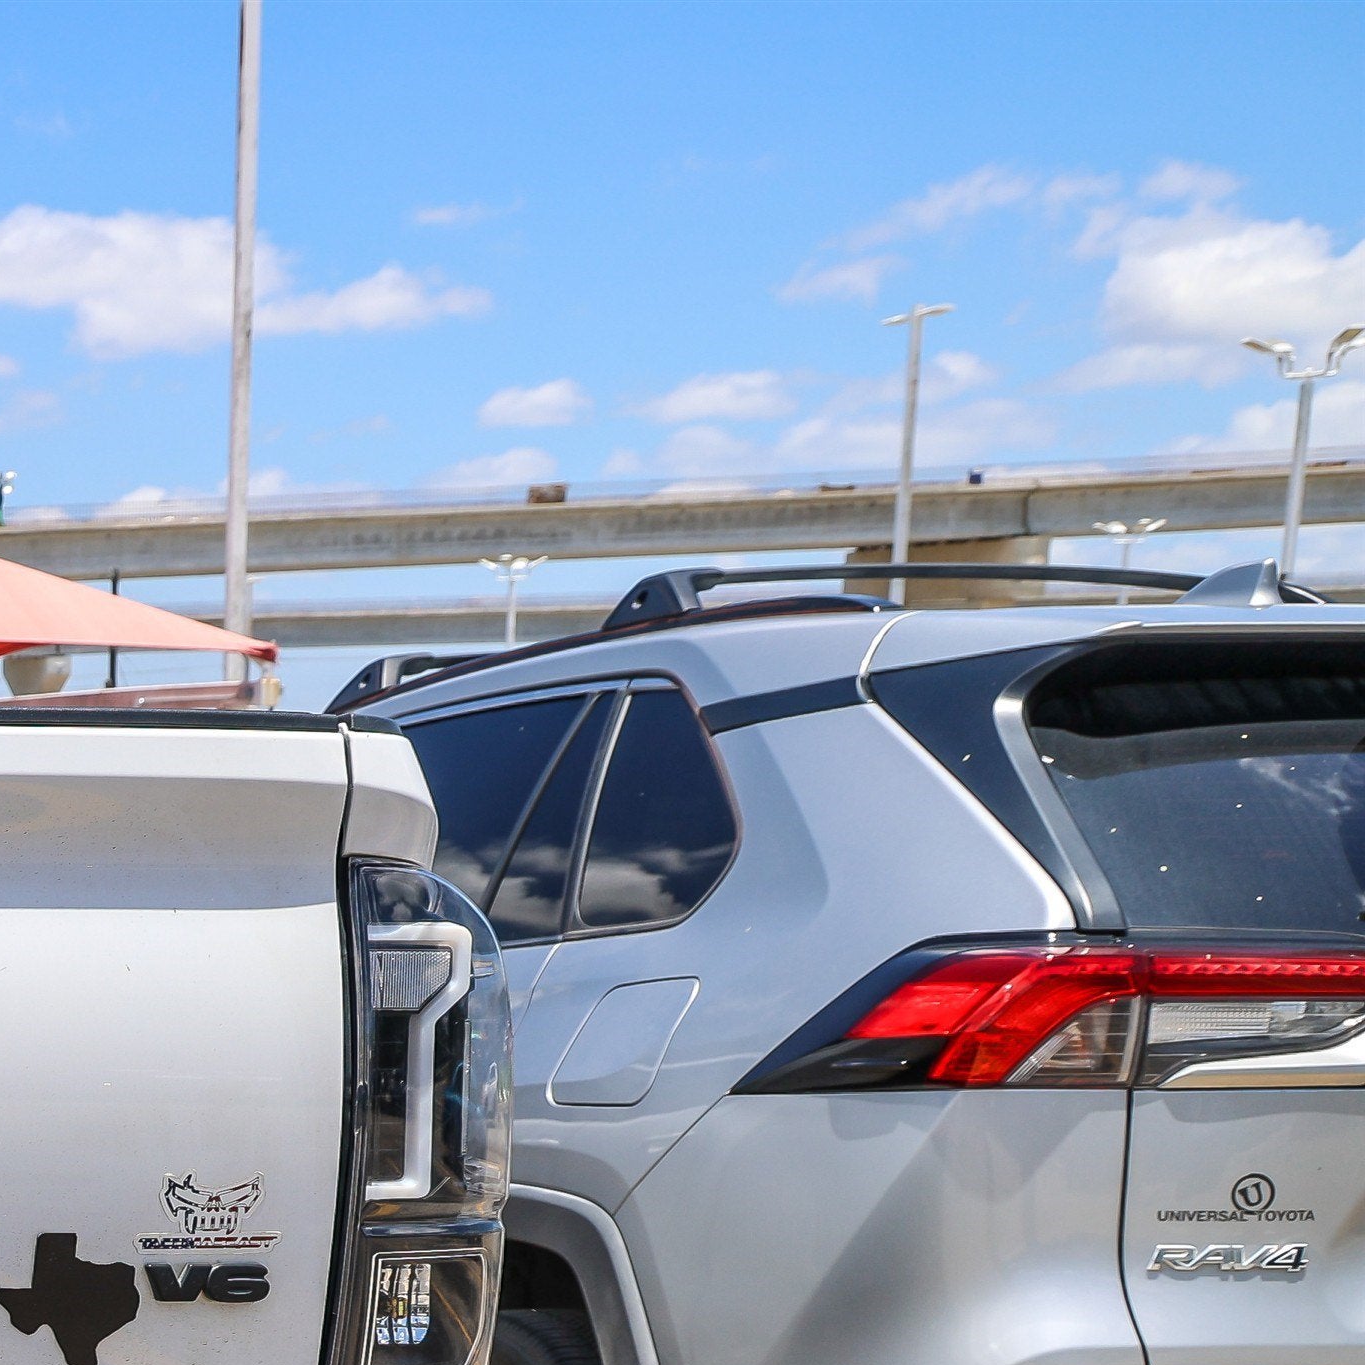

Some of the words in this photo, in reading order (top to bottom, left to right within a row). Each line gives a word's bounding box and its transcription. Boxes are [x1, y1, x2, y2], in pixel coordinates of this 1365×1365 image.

[1157, 1210, 1248, 1222] UNIVERSAL
[1255, 1209, 1315, 1222] TOYOTA
[1146, 1243, 1310, 1272] RAV4
[143, 1262, 271, 1302] V6
